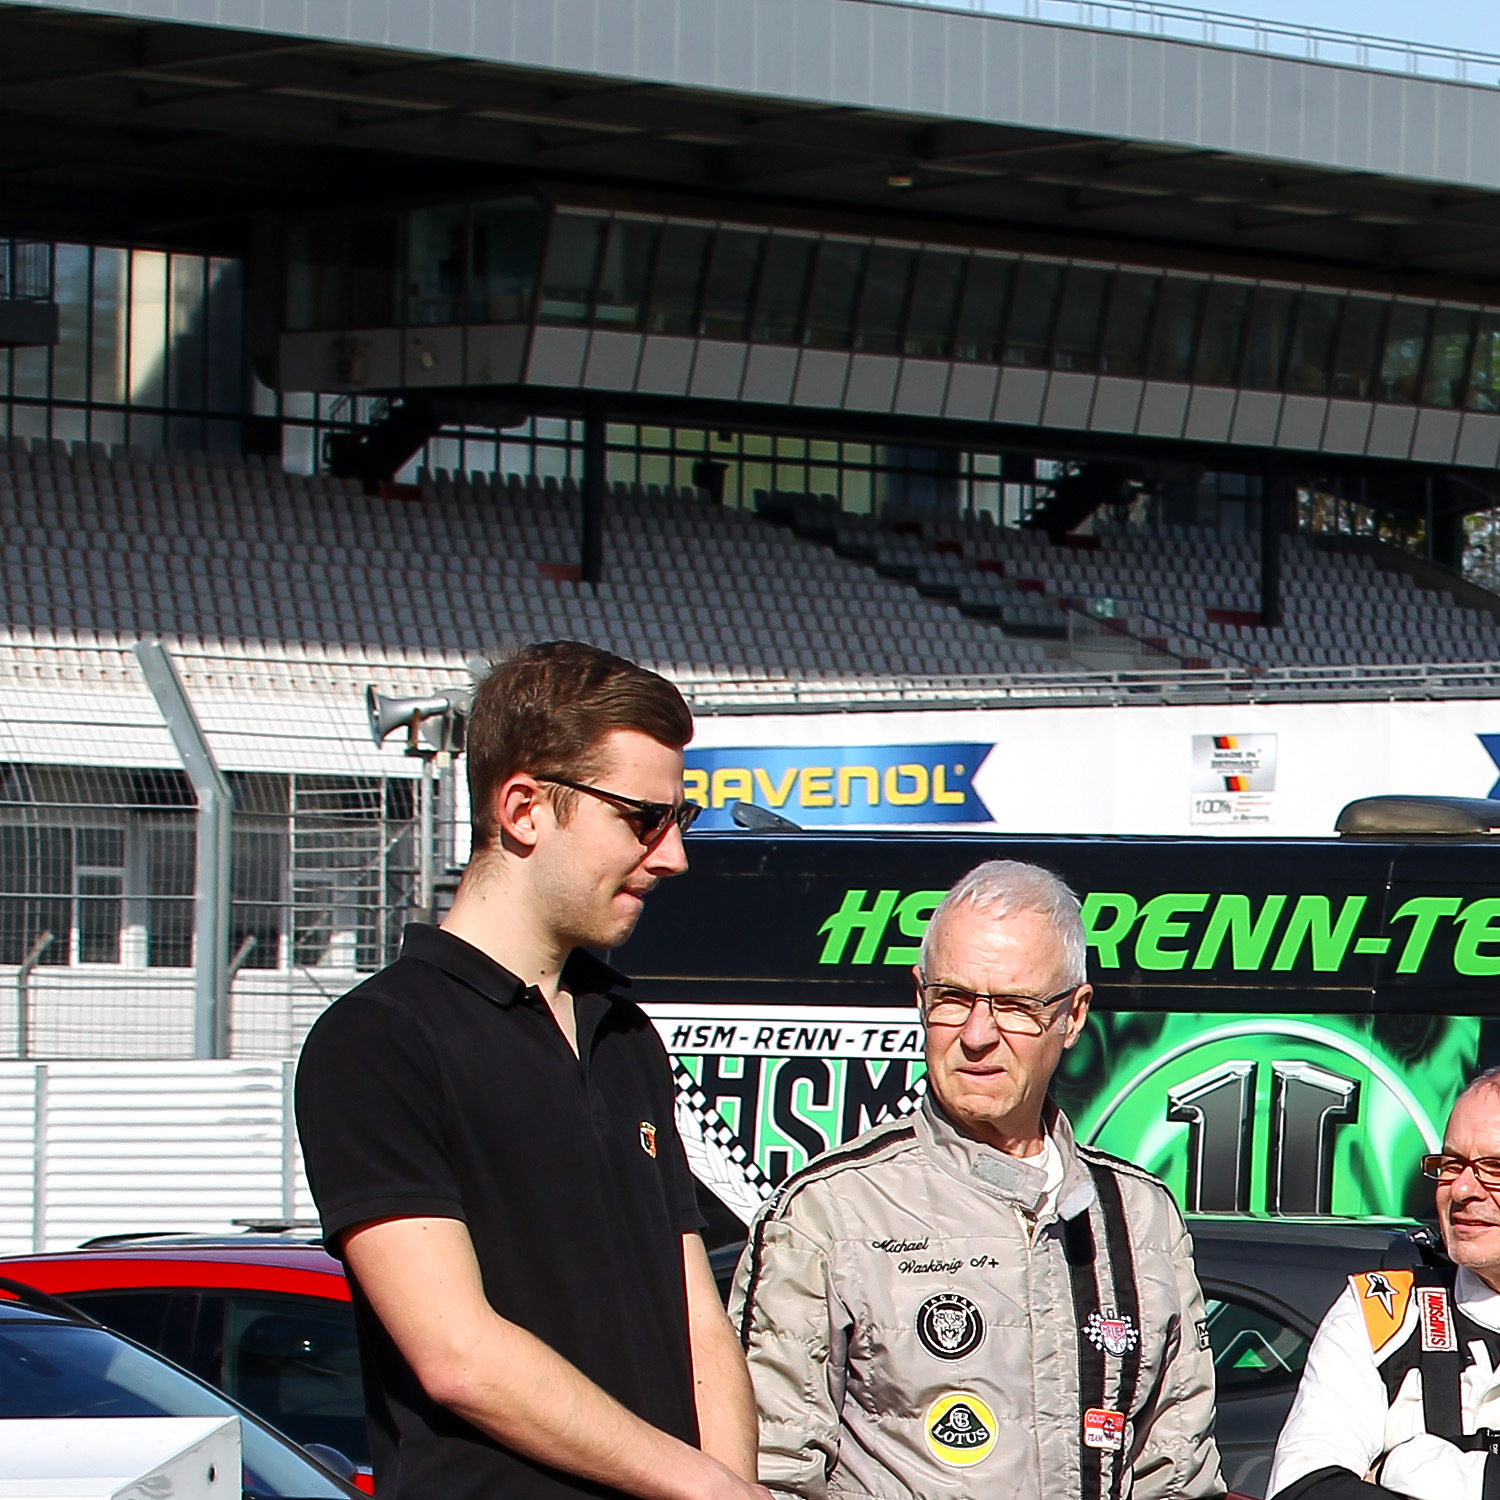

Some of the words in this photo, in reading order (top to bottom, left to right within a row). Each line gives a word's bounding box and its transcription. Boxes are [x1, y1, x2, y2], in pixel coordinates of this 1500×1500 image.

[670, 1024, 924, 1053] HSM-RENN-TEA
[872, 1236, 929, 1254] Michael
[1430, 1292, 1447, 1347] SIMPSON
[933, 1424, 989, 1445] LOTUS
